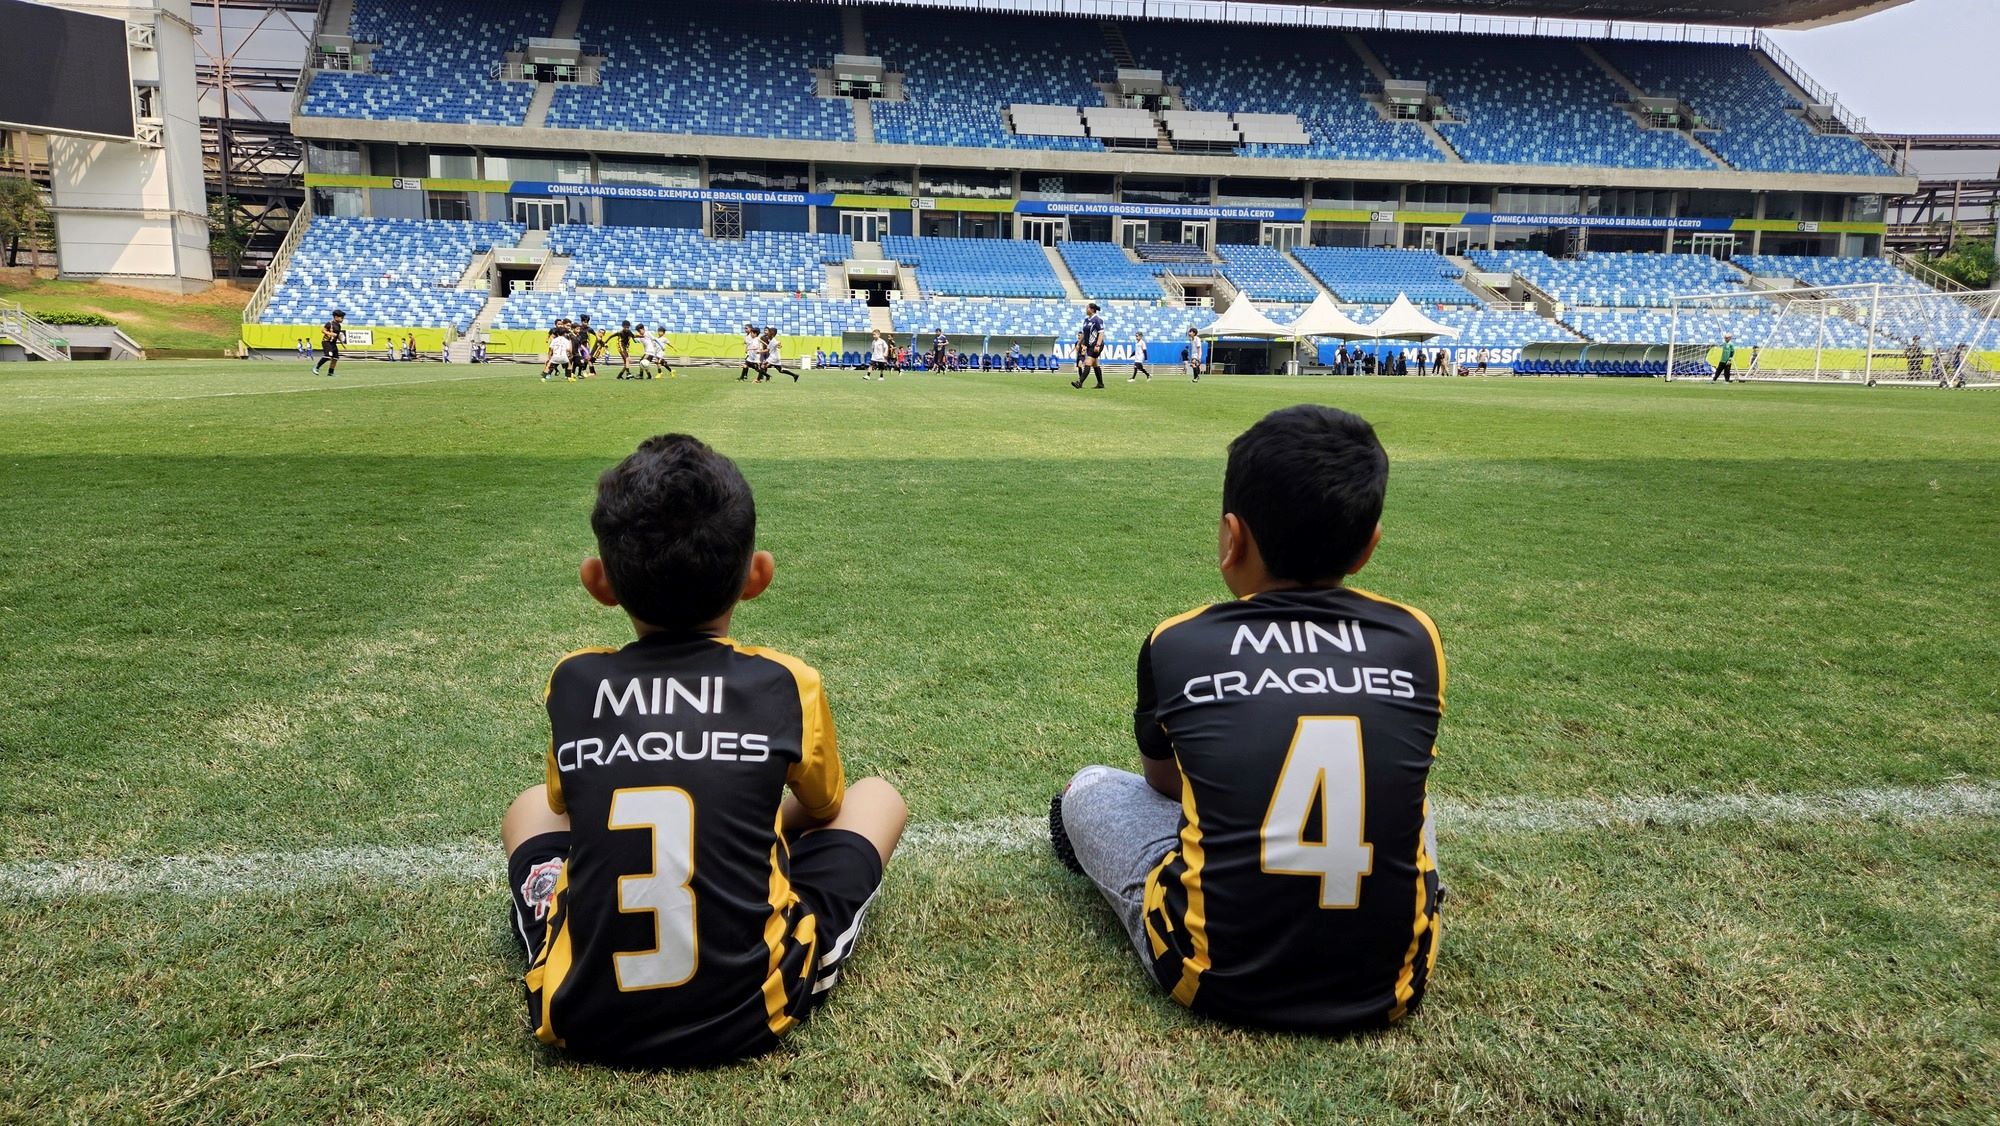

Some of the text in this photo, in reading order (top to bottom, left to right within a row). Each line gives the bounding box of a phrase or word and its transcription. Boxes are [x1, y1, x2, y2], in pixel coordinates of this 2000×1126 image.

[547, 184, 805, 203] CONHEÇA MATO GROSSO: EXEMPLO DE BRASIL QUE DÁ CERTO
[1047, 203, 1275, 218] CONHEÇA MATO GROSSO: EXEMPLO DE BRASIL QUE DÁ CERTO
[1492, 215, 1701, 228] CONHEÇA MATO GROSSO: EXEMPLO DE BRASIL QUE DÁ CERTO
[1229, 619, 1367, 656] MINI
[592, 675, 724, 719] MINI
[1182, 666, 1416, 704] CRAQUES
[556, 730, 770, 773] CRAQUES
[1260, 714, 1374, 910] 4
[607, 784, 699, 993] 3
